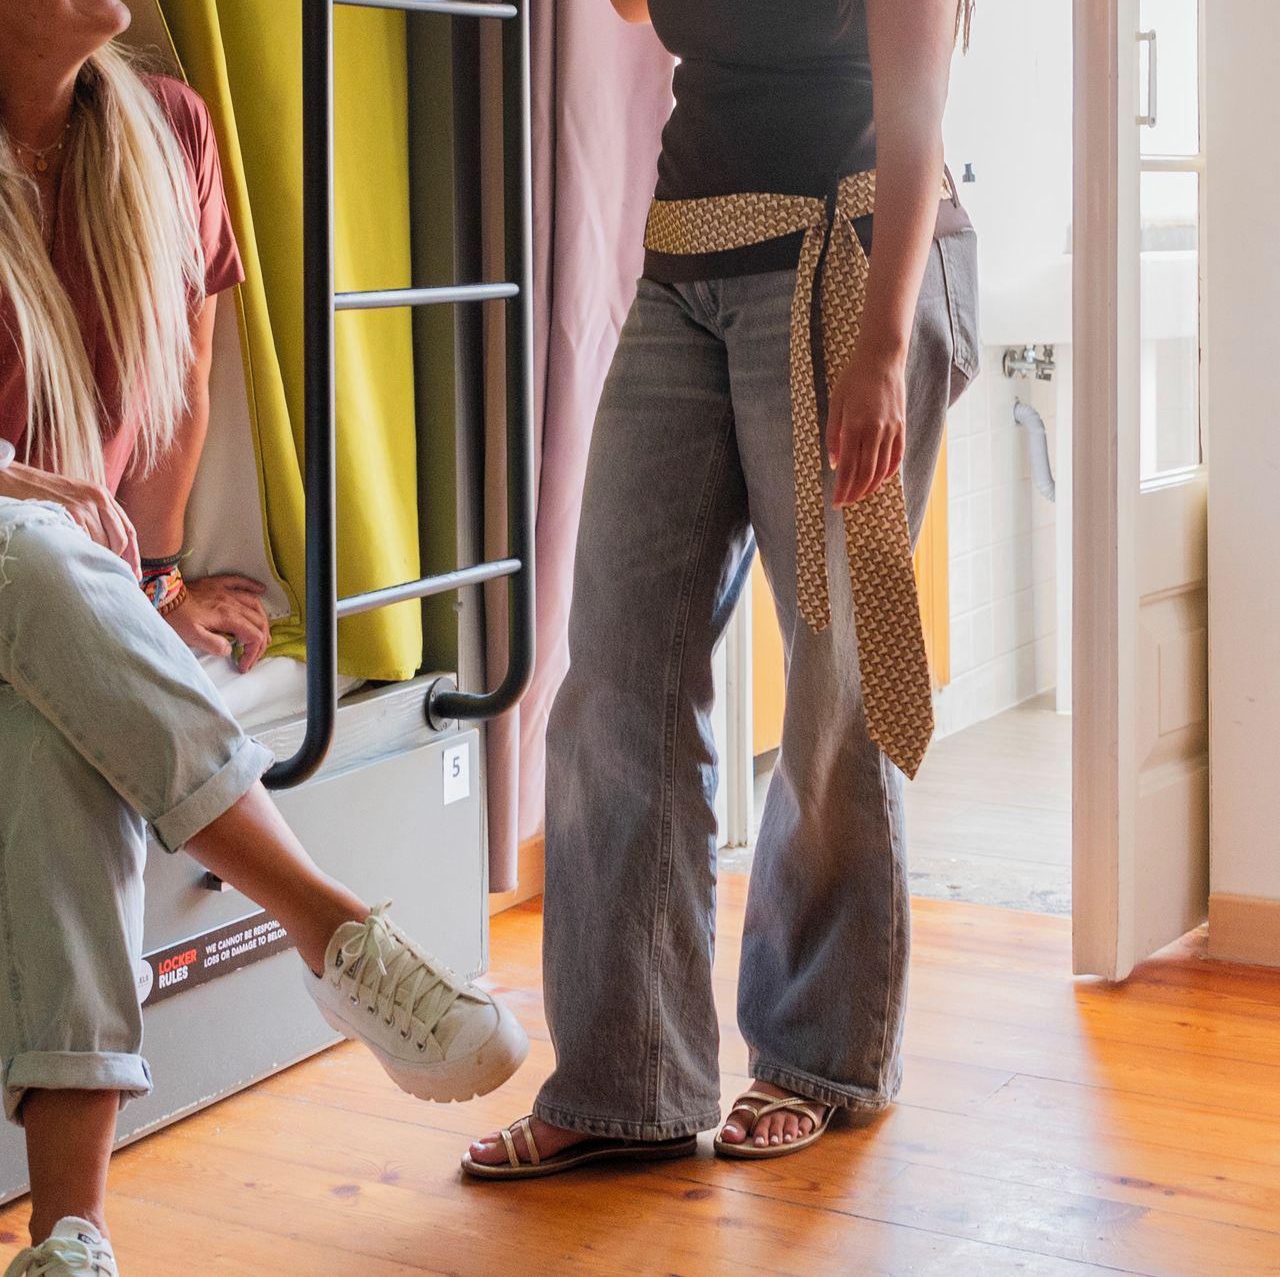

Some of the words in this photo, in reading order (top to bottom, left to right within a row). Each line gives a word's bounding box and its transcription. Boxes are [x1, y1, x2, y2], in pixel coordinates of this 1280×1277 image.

[452, 755, 460, 778] 5
[204, 954, 220, 968] LOSS
[220, 950, 230, 962] OR
[231, 938, 257, 957] DAMAGE
[258, 936, 267, 947] TO
[267, 928, 287, 944] BELON
[205, 942, 217, 955] WE
[217, 933, 244, 950] CANNOT
[244, 928, 252, 939] BE
[253, 920, 280, 938] RESPON
[158, 949, 197, 975] LOCKER
[158, 966, 189, 989] RULES
